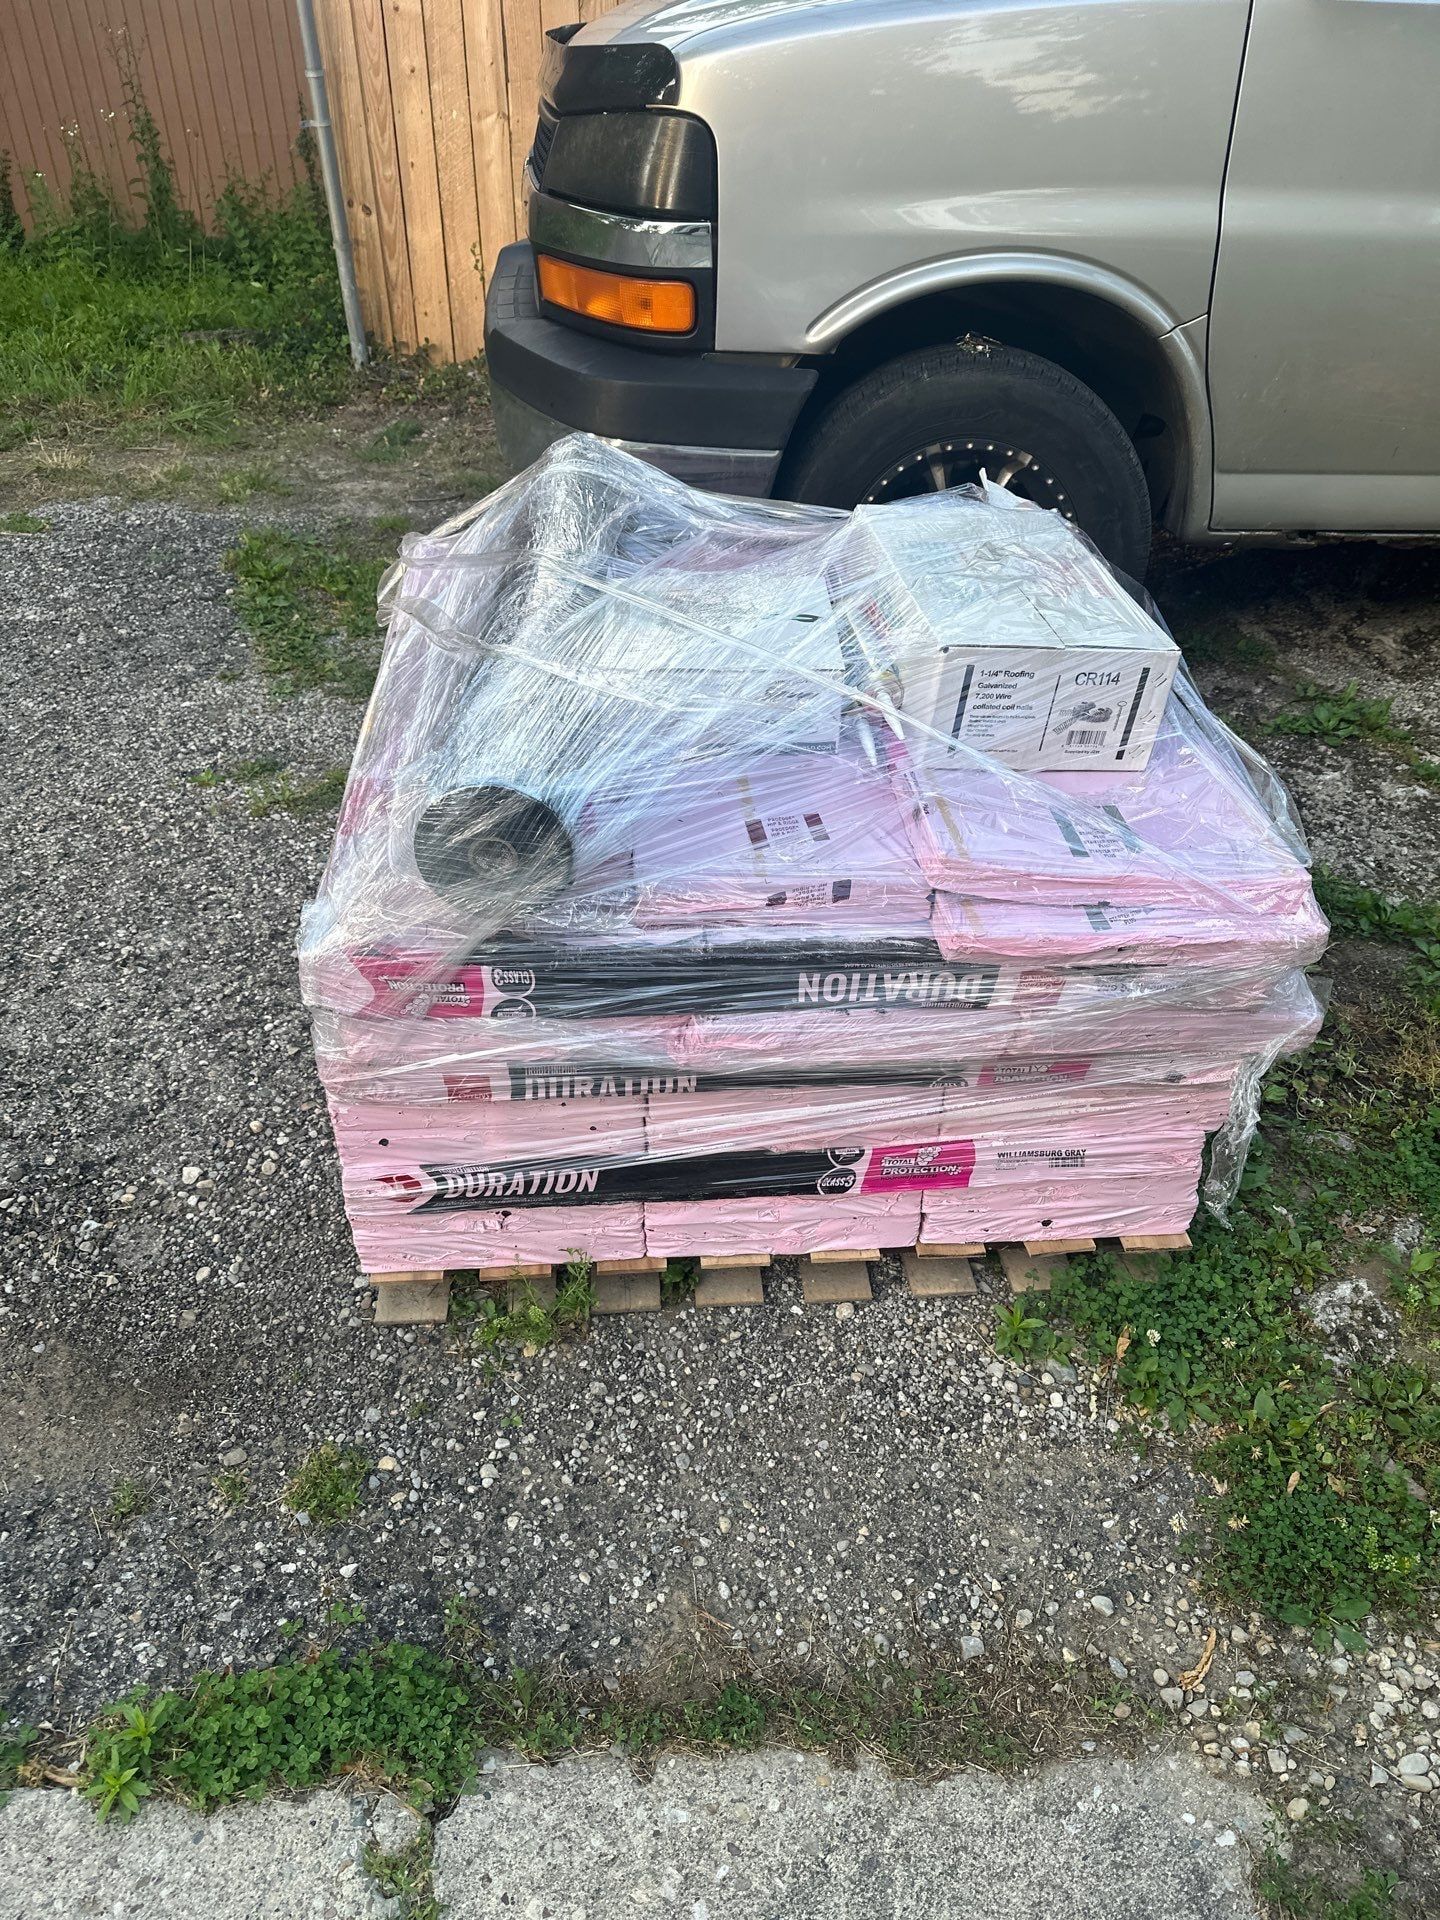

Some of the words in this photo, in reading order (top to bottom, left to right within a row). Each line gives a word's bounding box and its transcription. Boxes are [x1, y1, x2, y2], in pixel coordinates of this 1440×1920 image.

[980, 669, 1003, 677] 1-1/4"
[1004, 670, 1035, 680] Roofing
[1074, 672, 1121, 686] CR114
[977, 682, 1018, 690] Galvanized
[797, 972, 983, 1003] DURATION
[436, 994, 465, 1003] TOTAL
[524, 1075, 698, 1101] DURATION
[997, 1149, 1063, 1159] WILLIAMSBURG
[1064, 1149, 1087, 1157] GRAY
[886, 1158, 914, 1166] TOTAL
[881, 1165, 956, 1176] PROTECTION
[442, 1168, 601, 1199] DURATION
